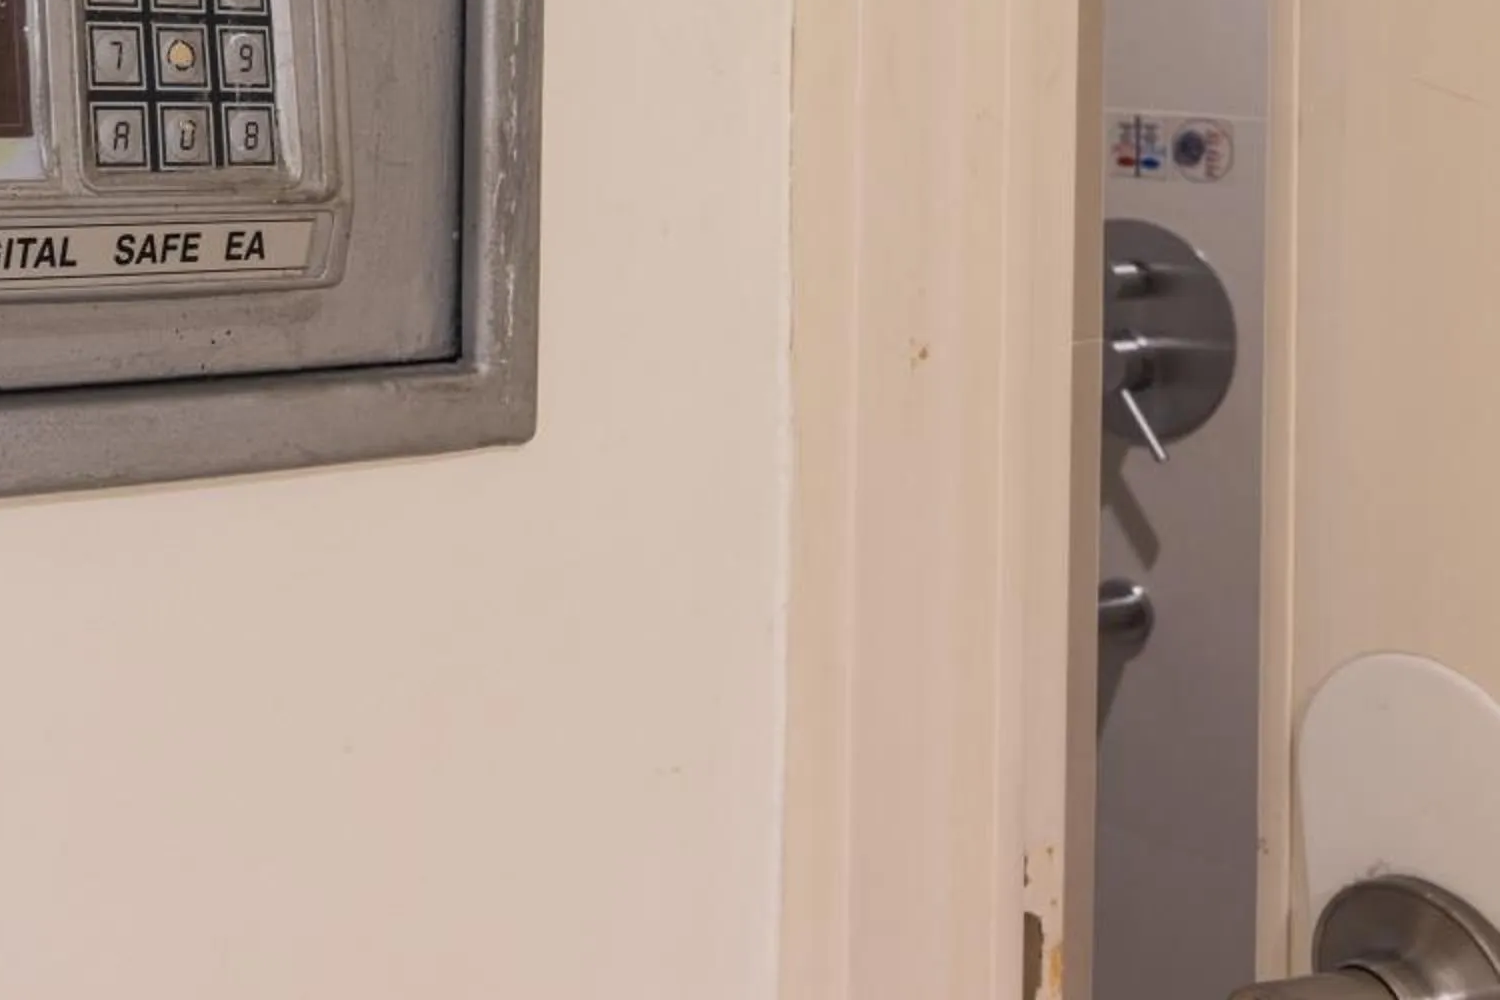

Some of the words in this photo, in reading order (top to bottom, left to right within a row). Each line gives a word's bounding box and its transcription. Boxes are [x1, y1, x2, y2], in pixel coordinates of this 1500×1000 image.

[110, 42, 123, 70] 7
[239, 43, 253, 72] 9
[113, 122, 129, 151] A
[113, 232, 202, 266] SAFE
[225, 229, 266, 261] EA
